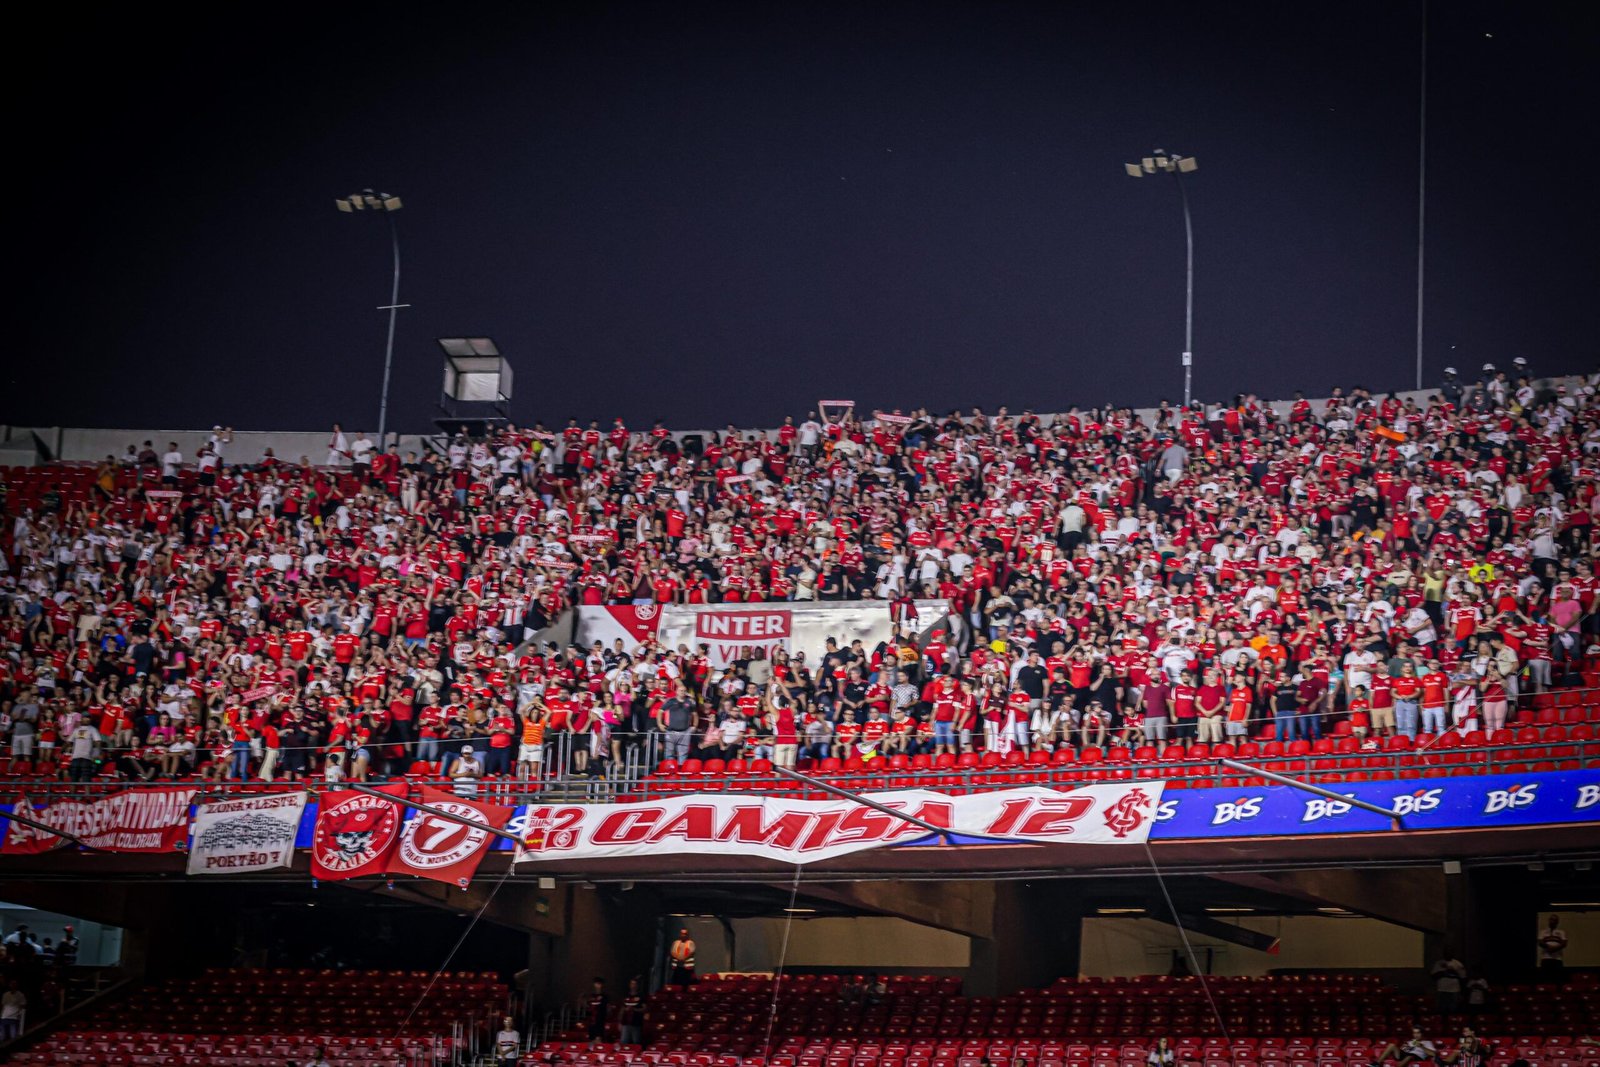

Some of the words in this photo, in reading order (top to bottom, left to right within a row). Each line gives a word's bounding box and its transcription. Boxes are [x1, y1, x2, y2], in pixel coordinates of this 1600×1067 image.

[701, 614, 785, 636] INTER
[422, 818, 465, 851] 7
[589, 801, 955, 853] CAMISA
[985, 796, 1097, 838] 12
[206, 851, 269, 869] PORTÃO
